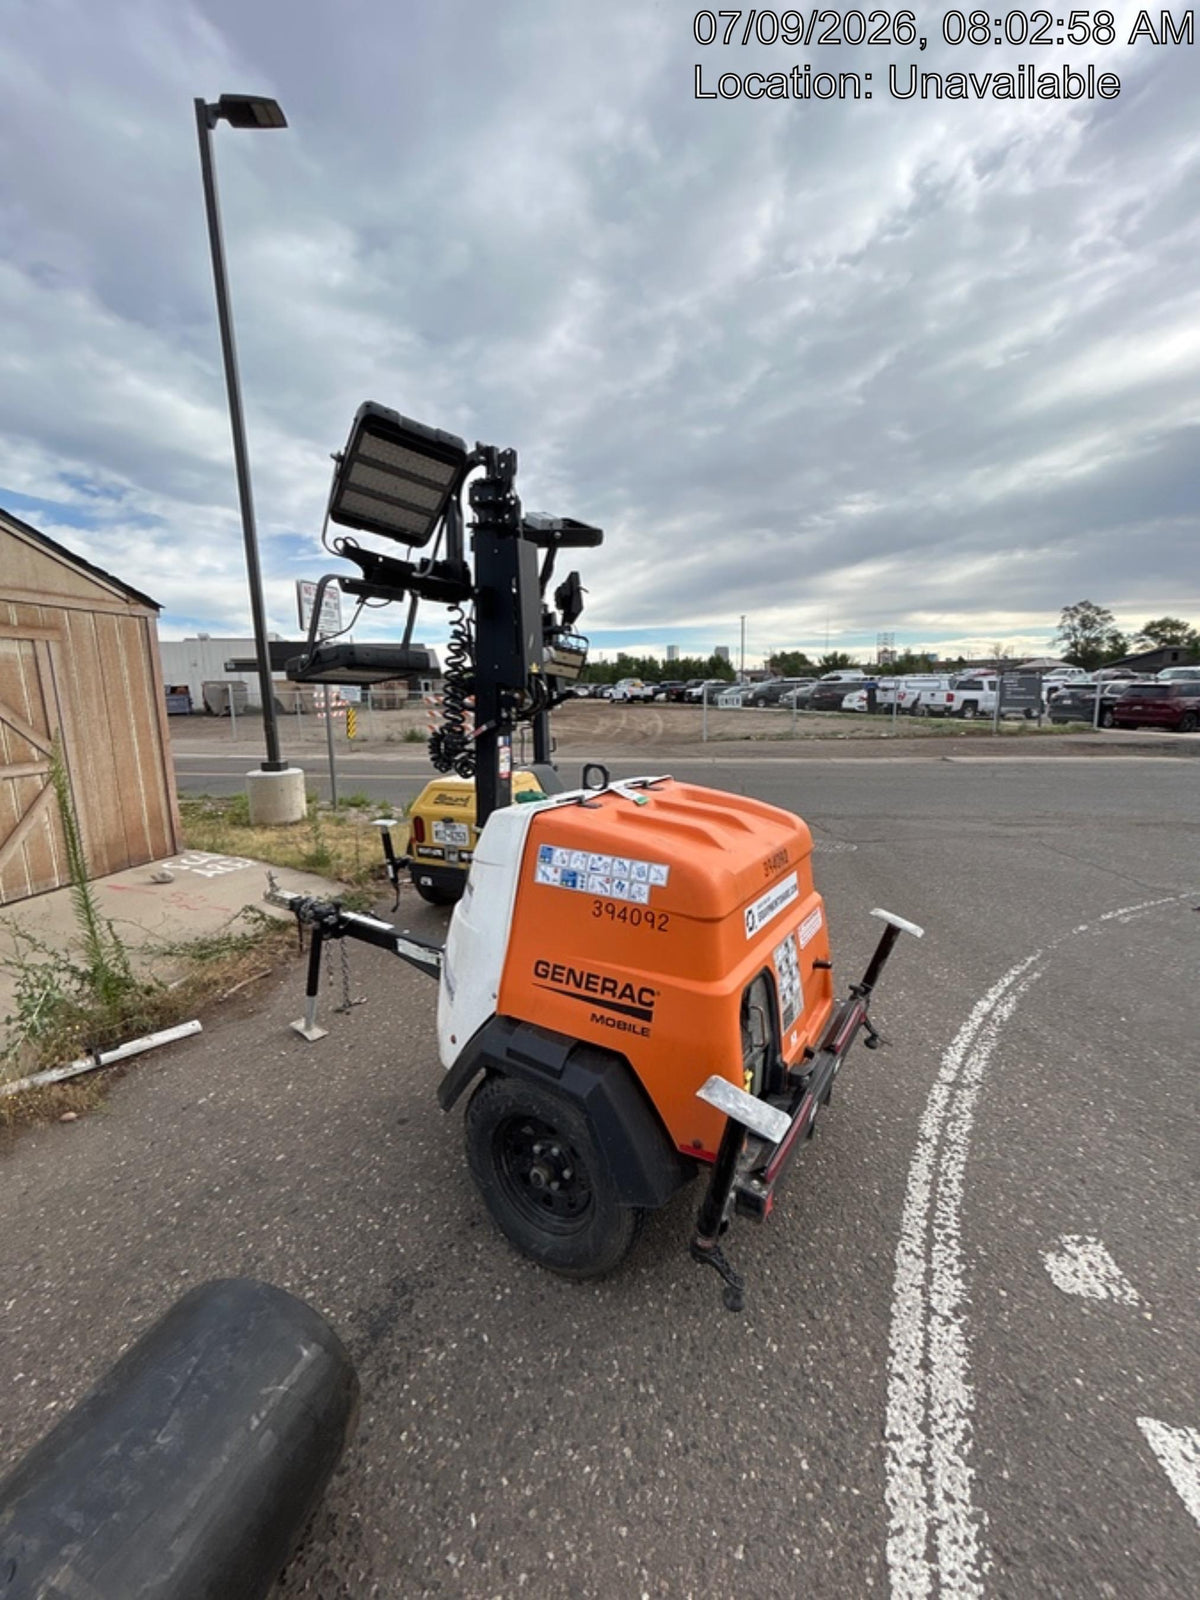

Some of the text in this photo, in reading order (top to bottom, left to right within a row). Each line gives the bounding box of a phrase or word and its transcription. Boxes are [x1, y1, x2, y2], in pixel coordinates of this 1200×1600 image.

[592, 899, 670, 932] 394092
[533, 959, 656, 1008] GENERAC
[590, 1012, 651, 1038] MOBILE
